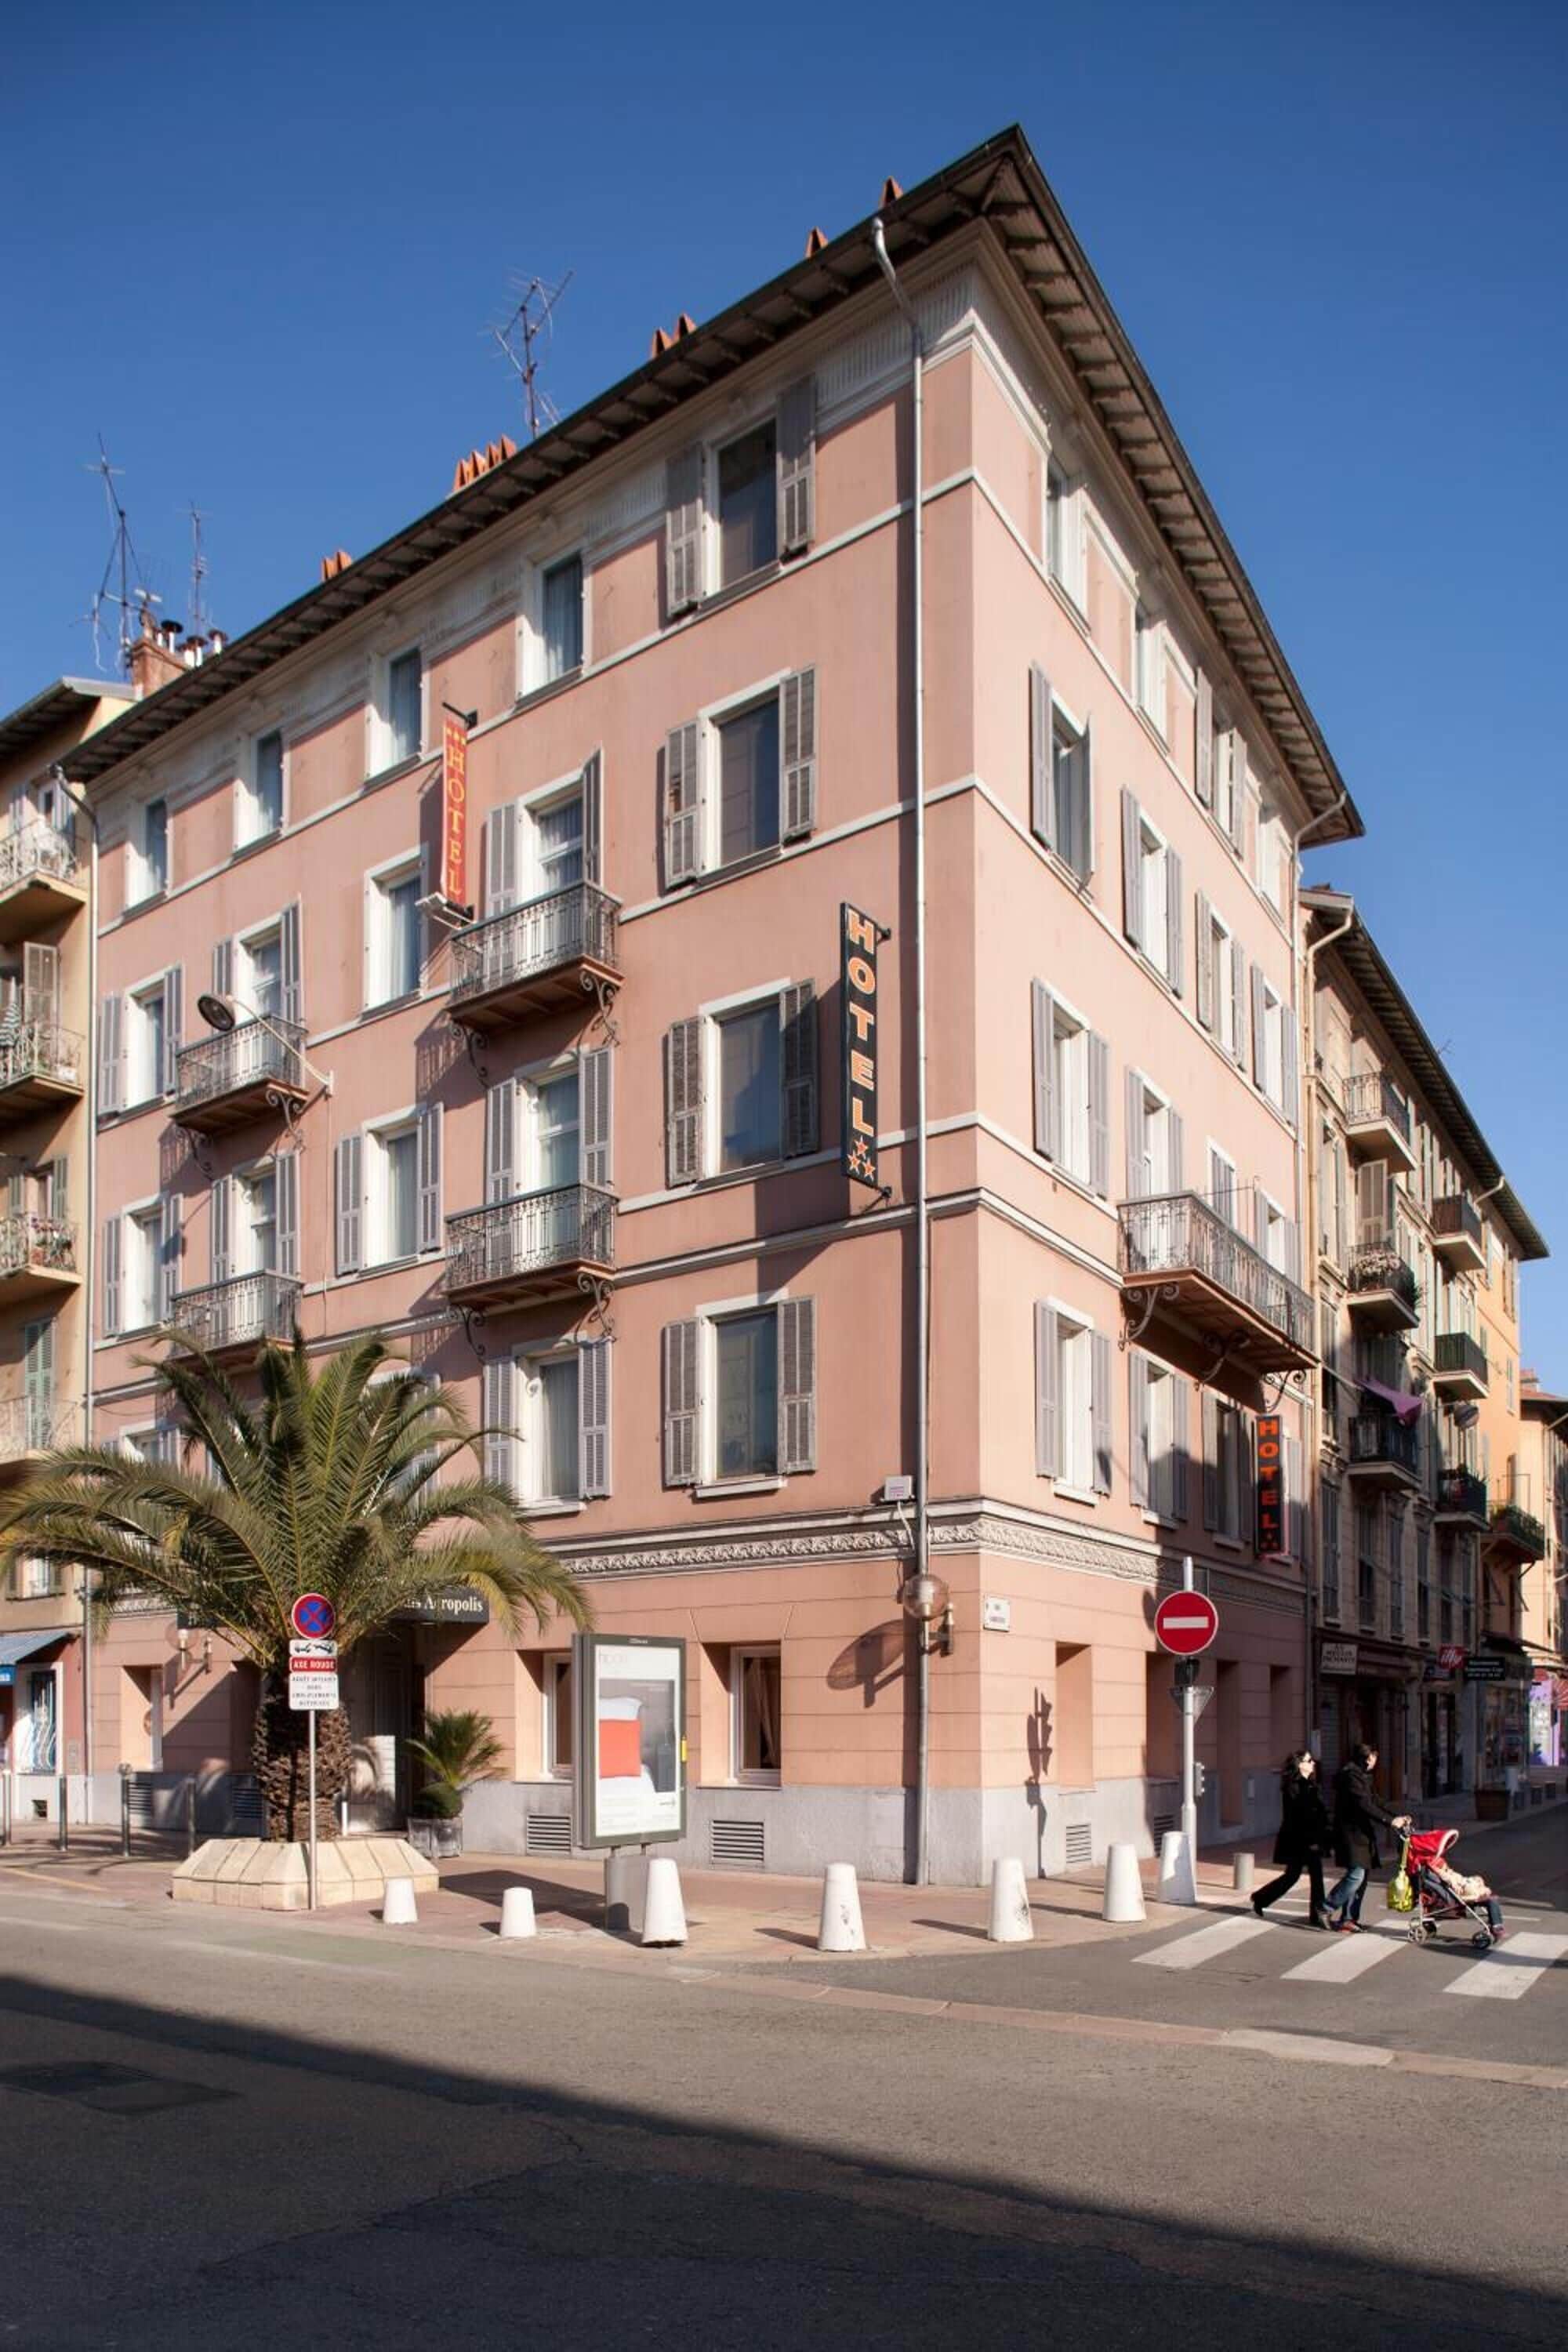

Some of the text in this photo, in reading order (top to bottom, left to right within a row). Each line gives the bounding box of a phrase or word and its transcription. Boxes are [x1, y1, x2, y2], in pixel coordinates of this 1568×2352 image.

[447, 745, 465, 895] HOTEL
[847, 909, 876, 1137] HOTEL
[1258, 1419, 1279, 1528] HOTEL
[293, 1660, 335, 1669] AXE ROUGE
